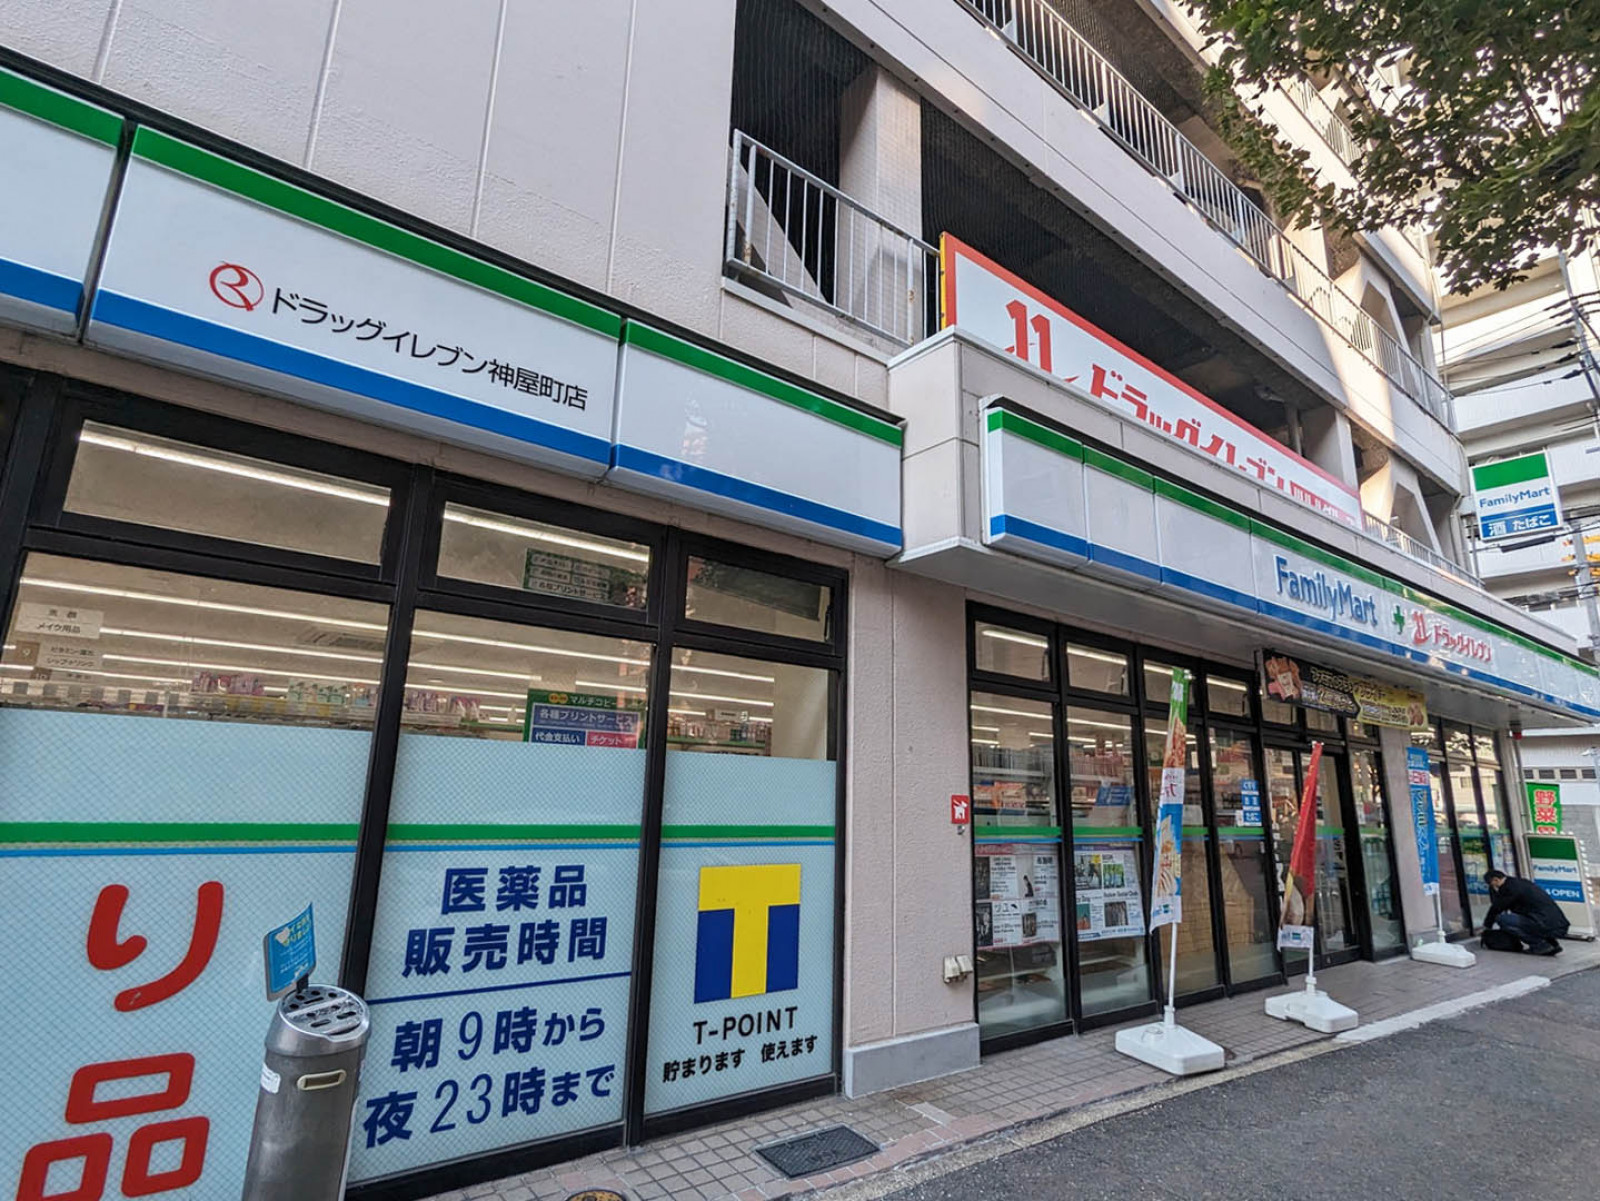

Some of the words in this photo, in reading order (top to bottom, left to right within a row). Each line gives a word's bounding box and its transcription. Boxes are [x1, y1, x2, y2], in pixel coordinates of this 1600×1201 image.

[271, 287, 588, 411] ドラッグイレブン神屋町店
[1479, 486, 1551, 508] FamilyMart
[1512, 514, 1552, 531] たばこ
[1275, 555, 1378, 627] FamilyMart
[535, 731, 581, 744] 代金支払い
[540, 708, 633, 727] 各種プリントサービス
[591, 735, 623, 747] チケット
[441, 864, 588, 915] 医薬品
[1532, 864, 1578, 874] FamilyMart
[402, 916, 608, 978] 販売時間
[390, 1005, 607, 1073] 朝9時から
[693, 1006, 799, 1045] T-POINT
[662, 1048, 746, 1083] 貯まります
[760, 1034, 818, 1063] 使えます
[363, 1064, 616, 1149] 夜23時まで
